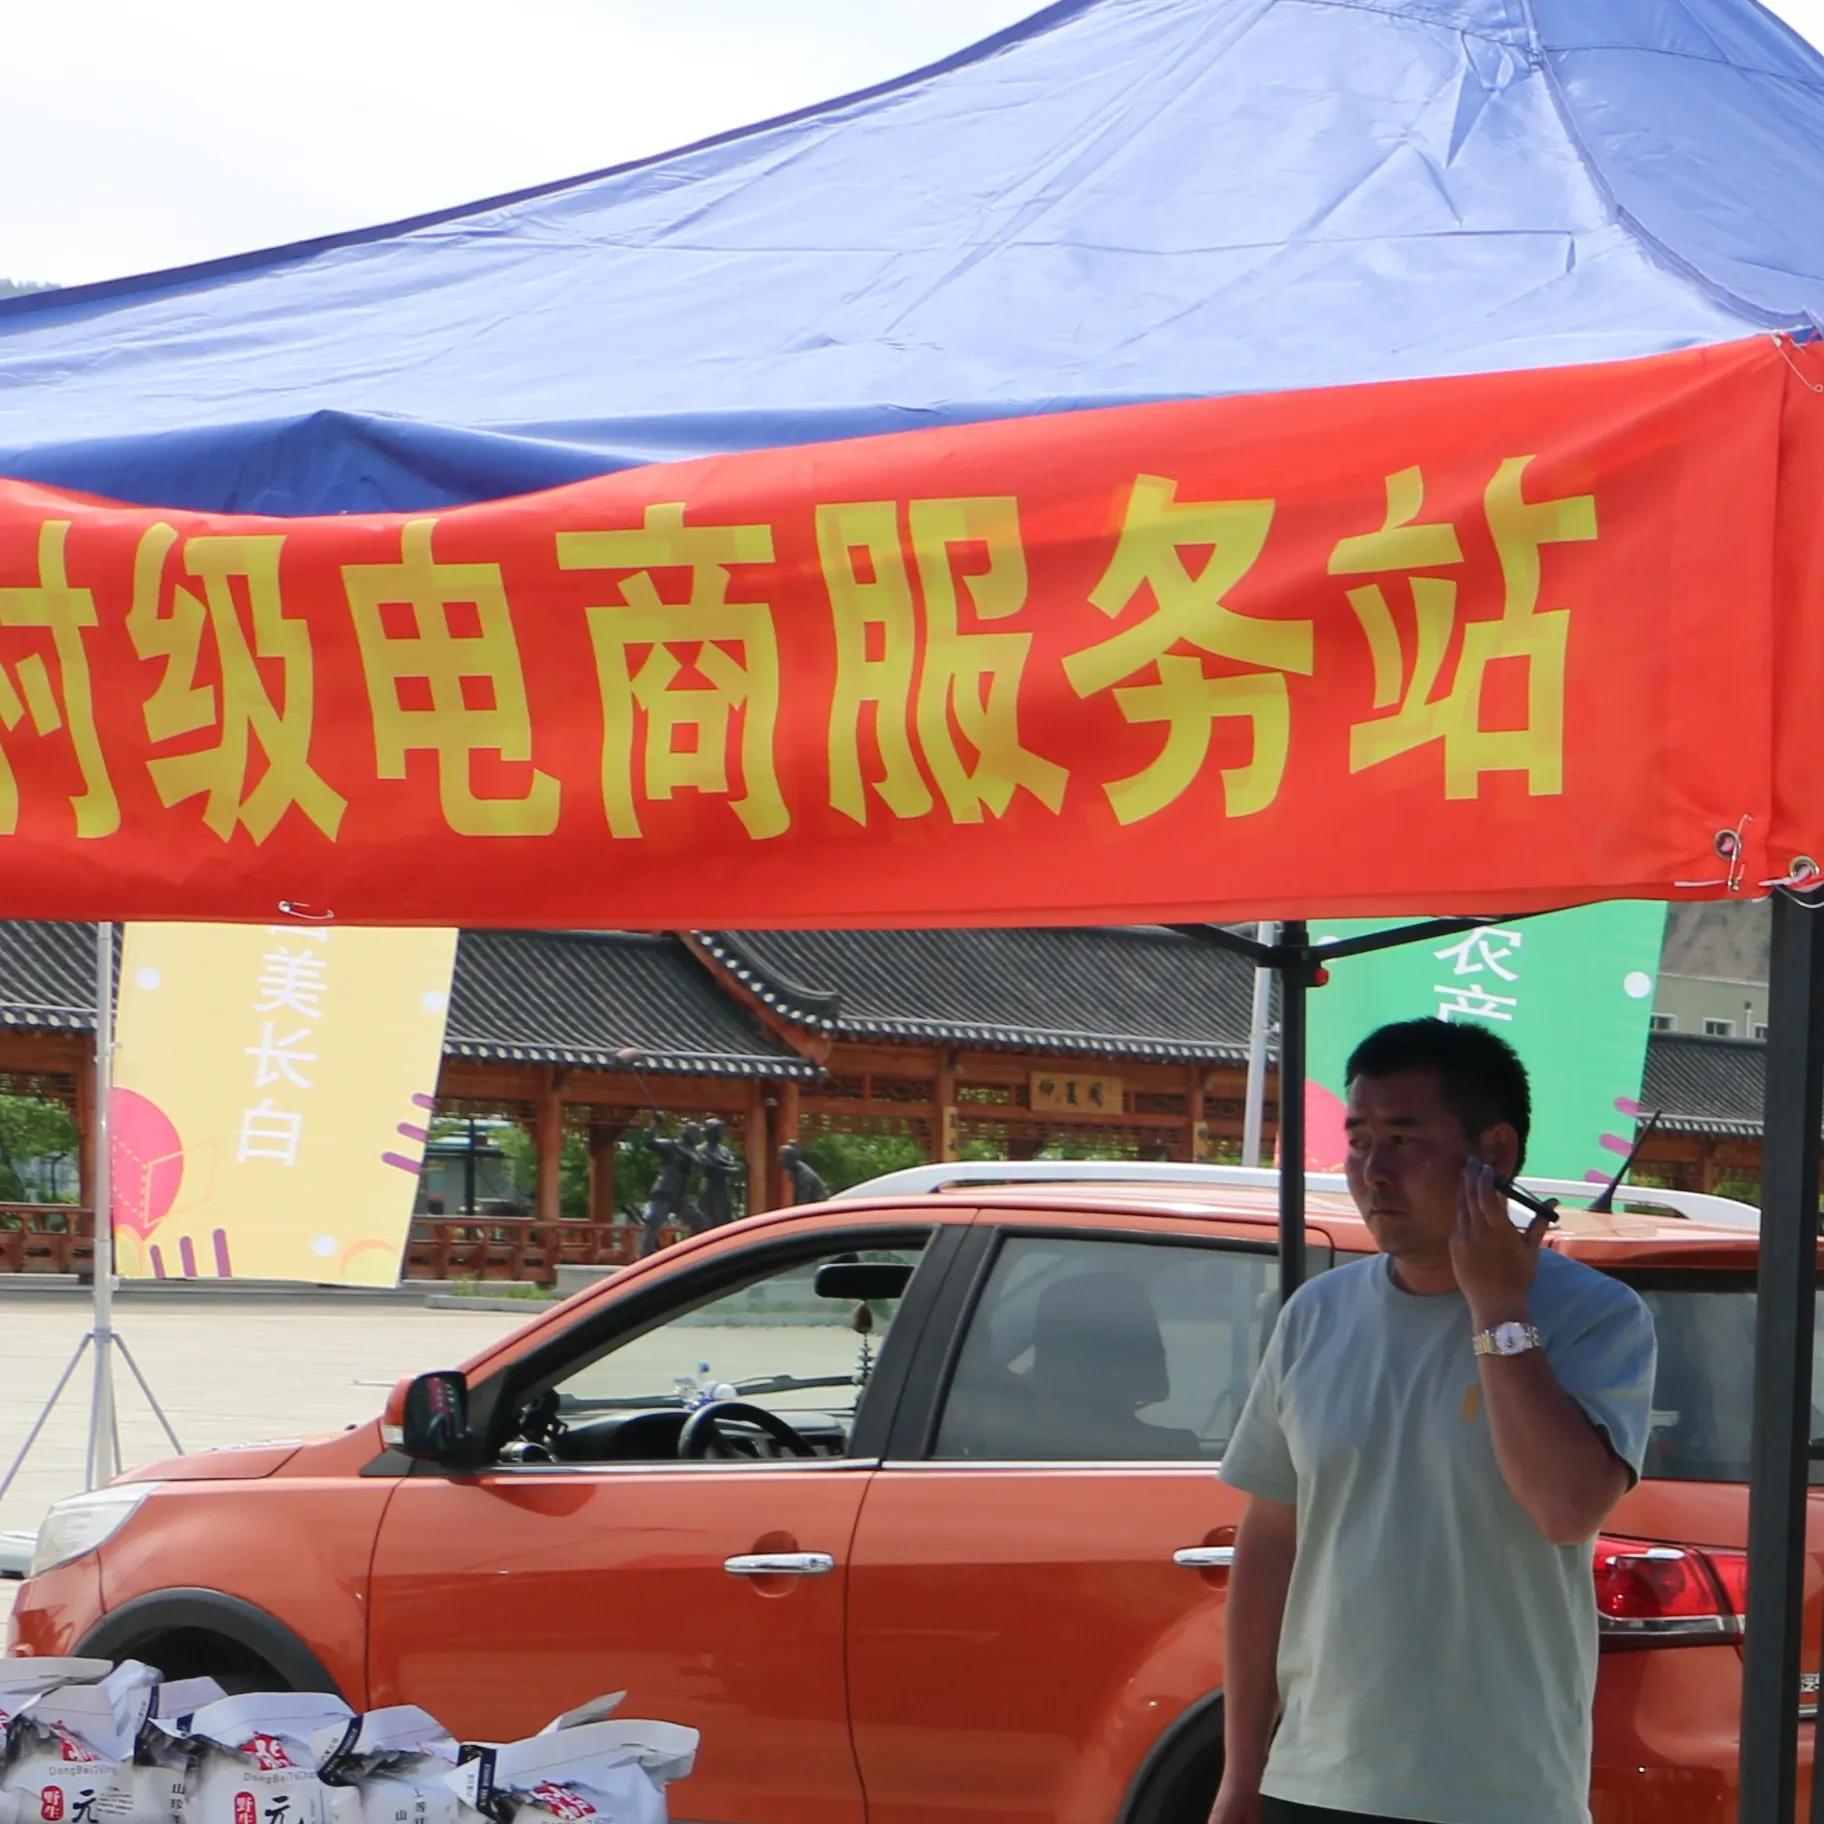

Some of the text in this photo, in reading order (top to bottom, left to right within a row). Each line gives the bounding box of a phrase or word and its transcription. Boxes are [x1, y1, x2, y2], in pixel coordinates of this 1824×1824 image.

[0, 455, 1597, 847] 村级电商服务站
[236, 925, 328, 1167] 美长白
[41, 1785, 64, 1821] 野生
